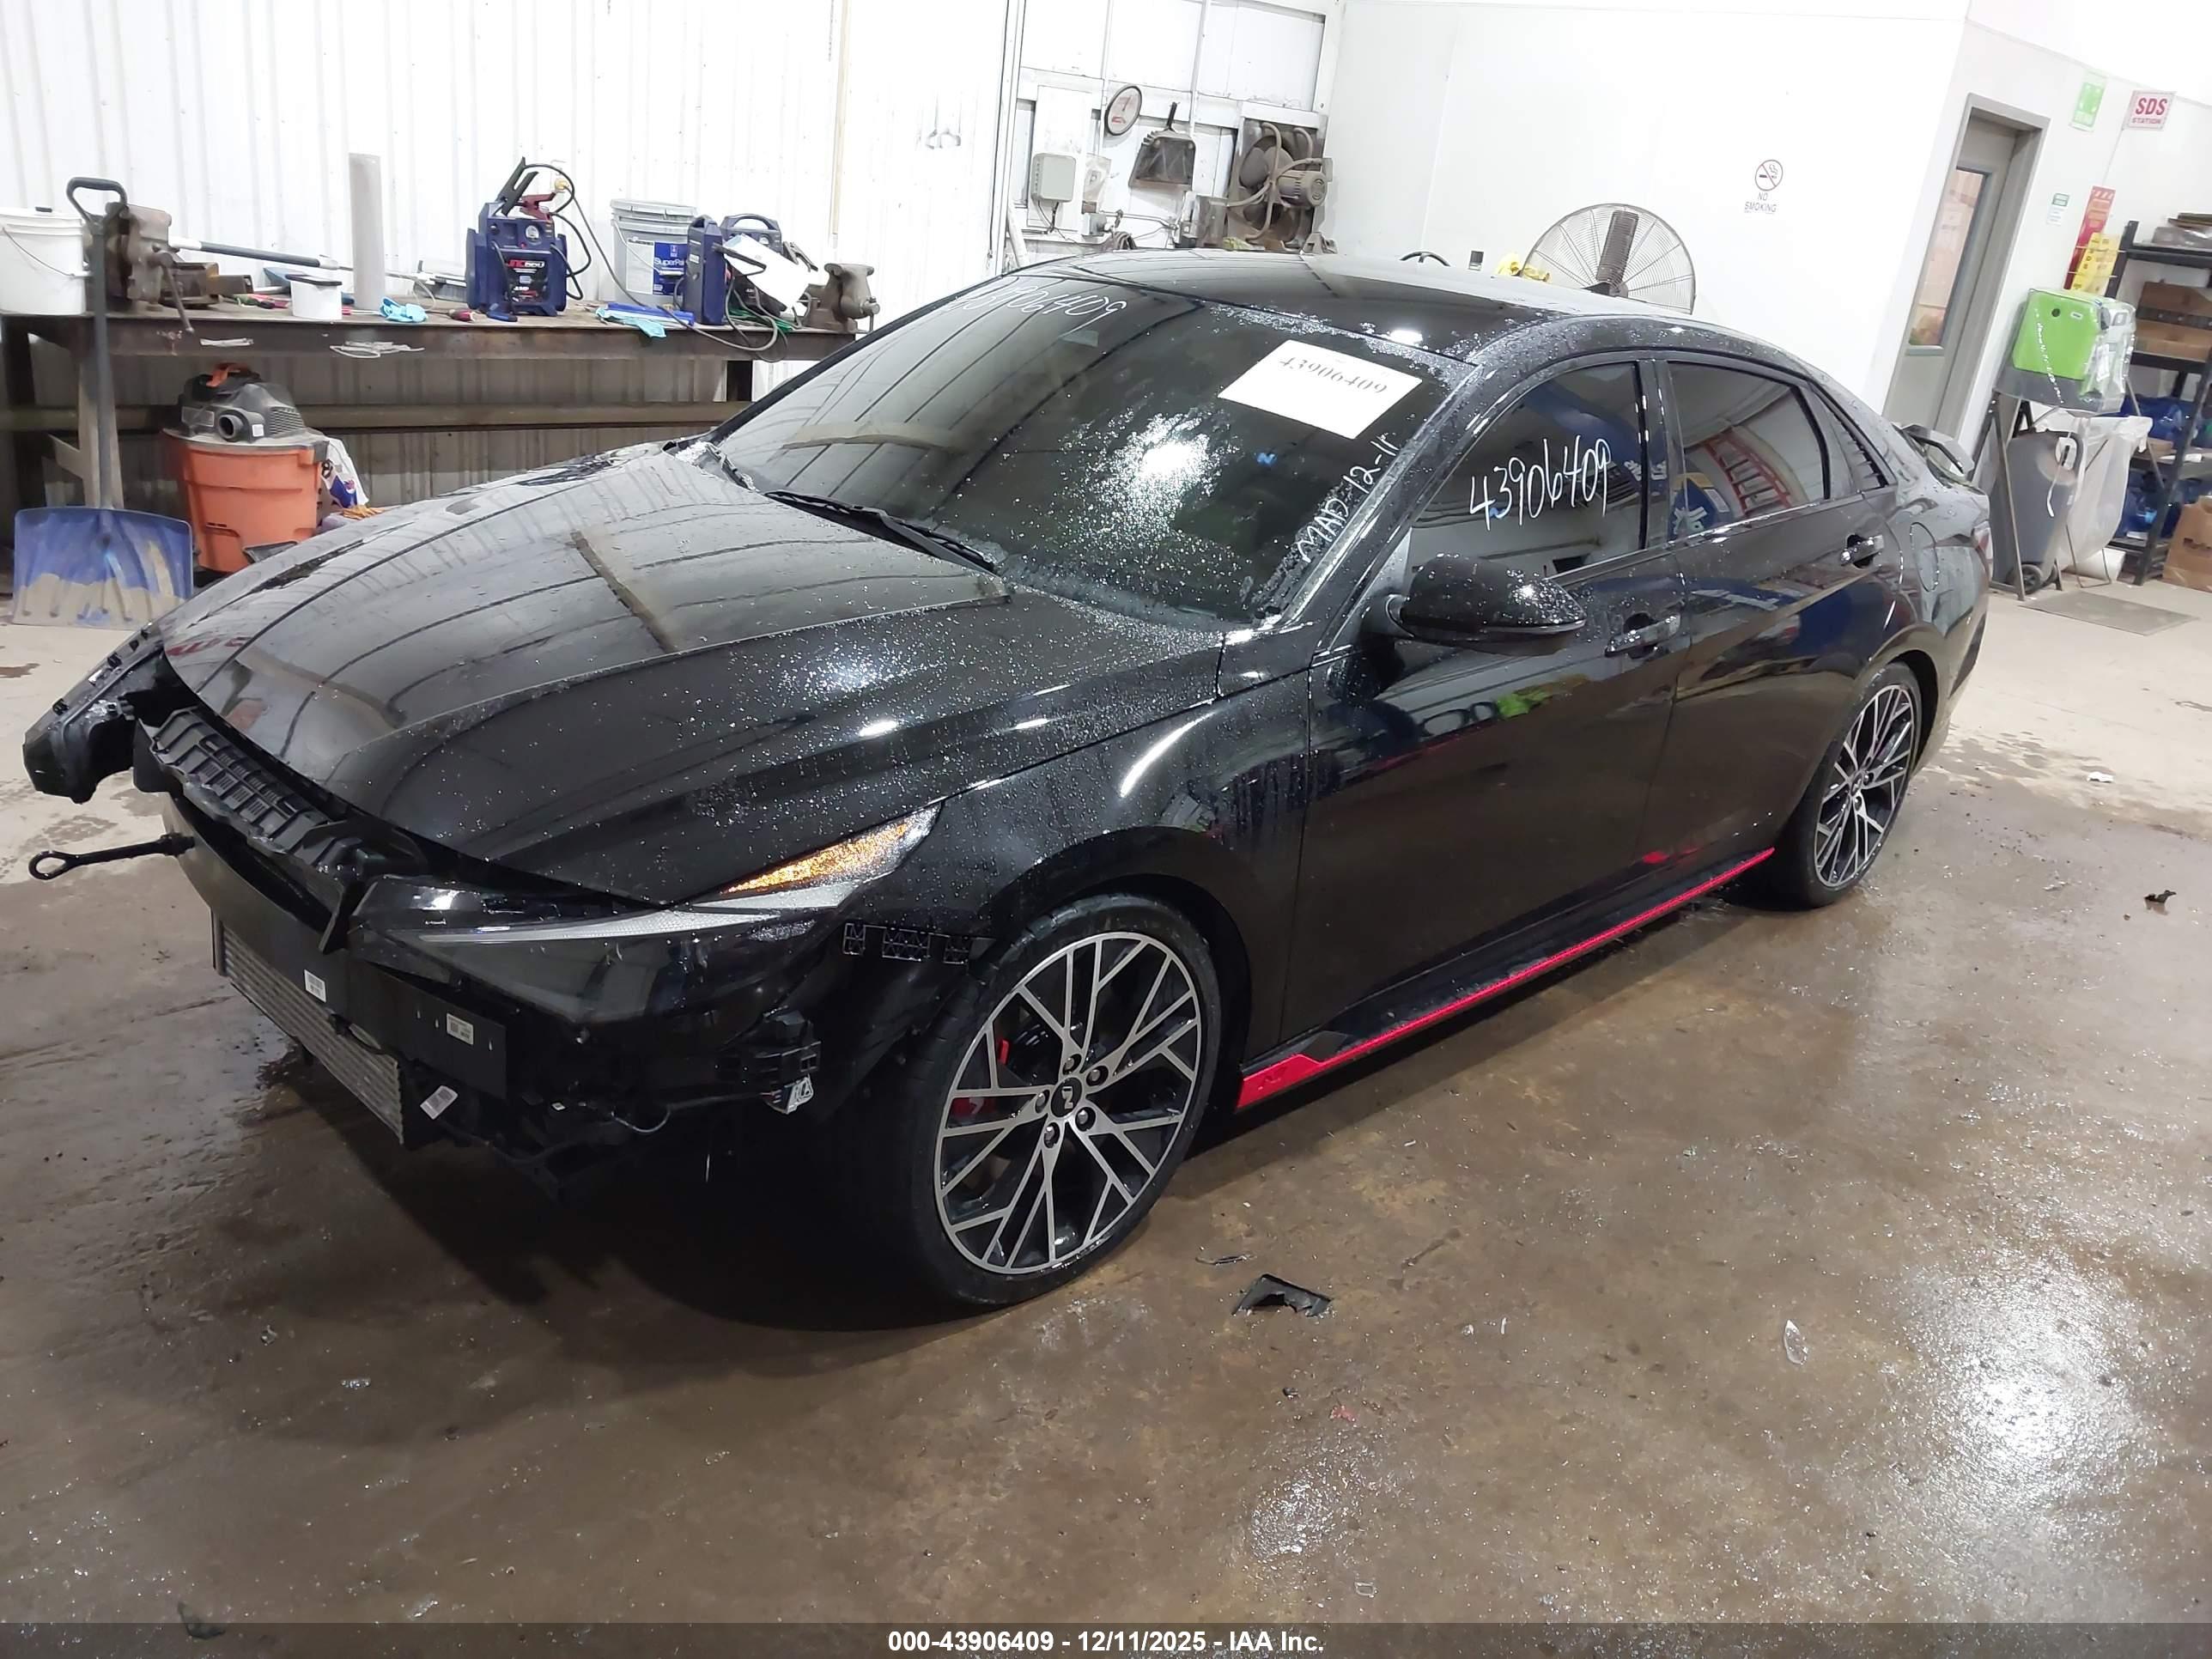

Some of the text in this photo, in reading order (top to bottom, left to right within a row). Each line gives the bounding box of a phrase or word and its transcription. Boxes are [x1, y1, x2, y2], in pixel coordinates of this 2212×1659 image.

[2136, 97, 2167, 115] SDS
[1757, 192, 1768, 201] NO
[1744, 201, 1777, 213] SMOKING
[1279, 356, 1388, 393] 43906409
[1469, 434, 1612, 532] 43906409
